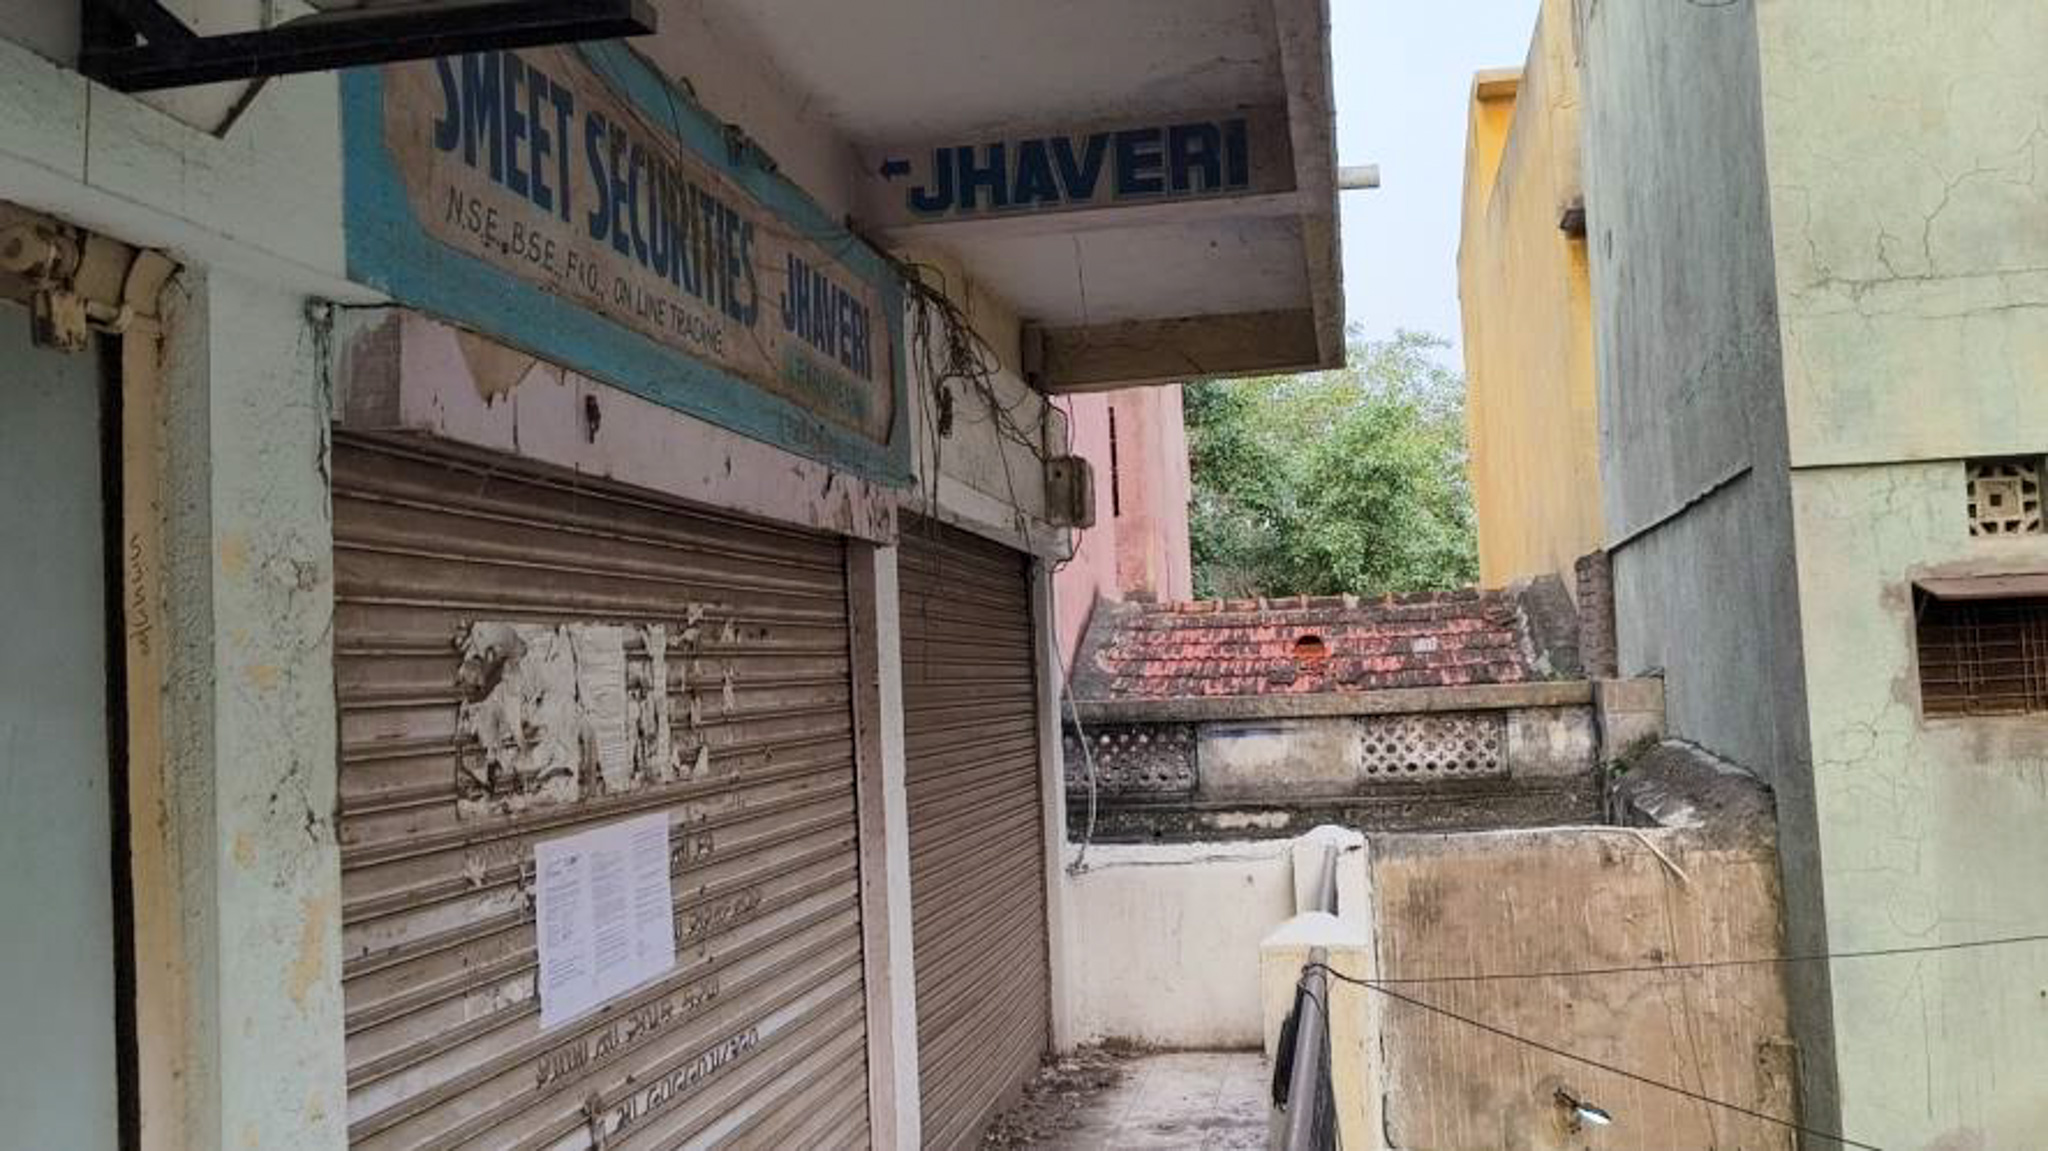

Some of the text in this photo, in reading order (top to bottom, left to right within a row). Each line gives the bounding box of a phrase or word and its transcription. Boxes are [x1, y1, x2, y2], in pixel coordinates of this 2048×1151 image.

[433, 49, 759, 329] SMEET SECURITIES
[909, 116, 1250, 217] JHAVERI
[780, 252, 873, 383] JHAVERI
